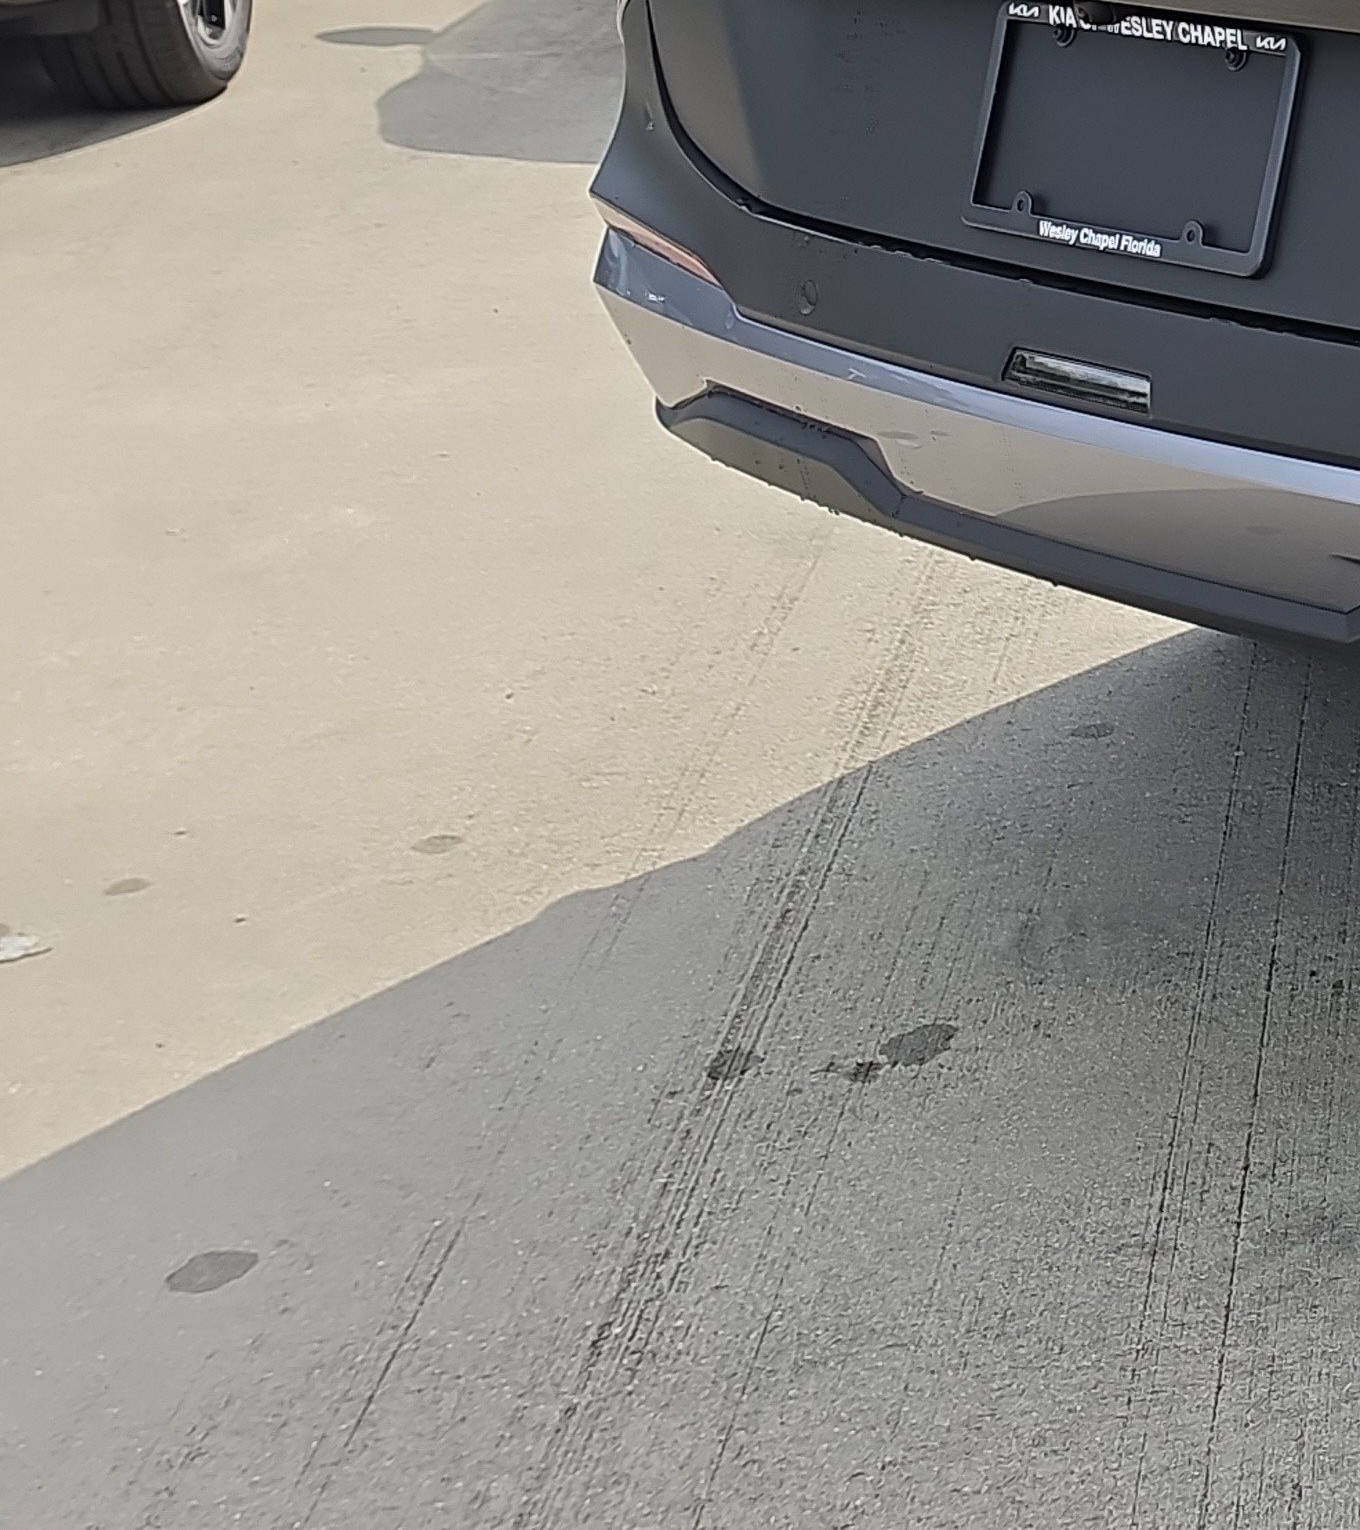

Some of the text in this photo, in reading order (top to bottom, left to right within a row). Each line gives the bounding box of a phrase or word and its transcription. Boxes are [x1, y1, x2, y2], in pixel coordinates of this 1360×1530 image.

[1048, 4, 1077, 28] KIA
[1106, 15, 1174, 41] ESLEY
[1177, 21, 1248, 50] CHAPEL
[1039, 220, 1161, 257] Wesley Chapel Florida
